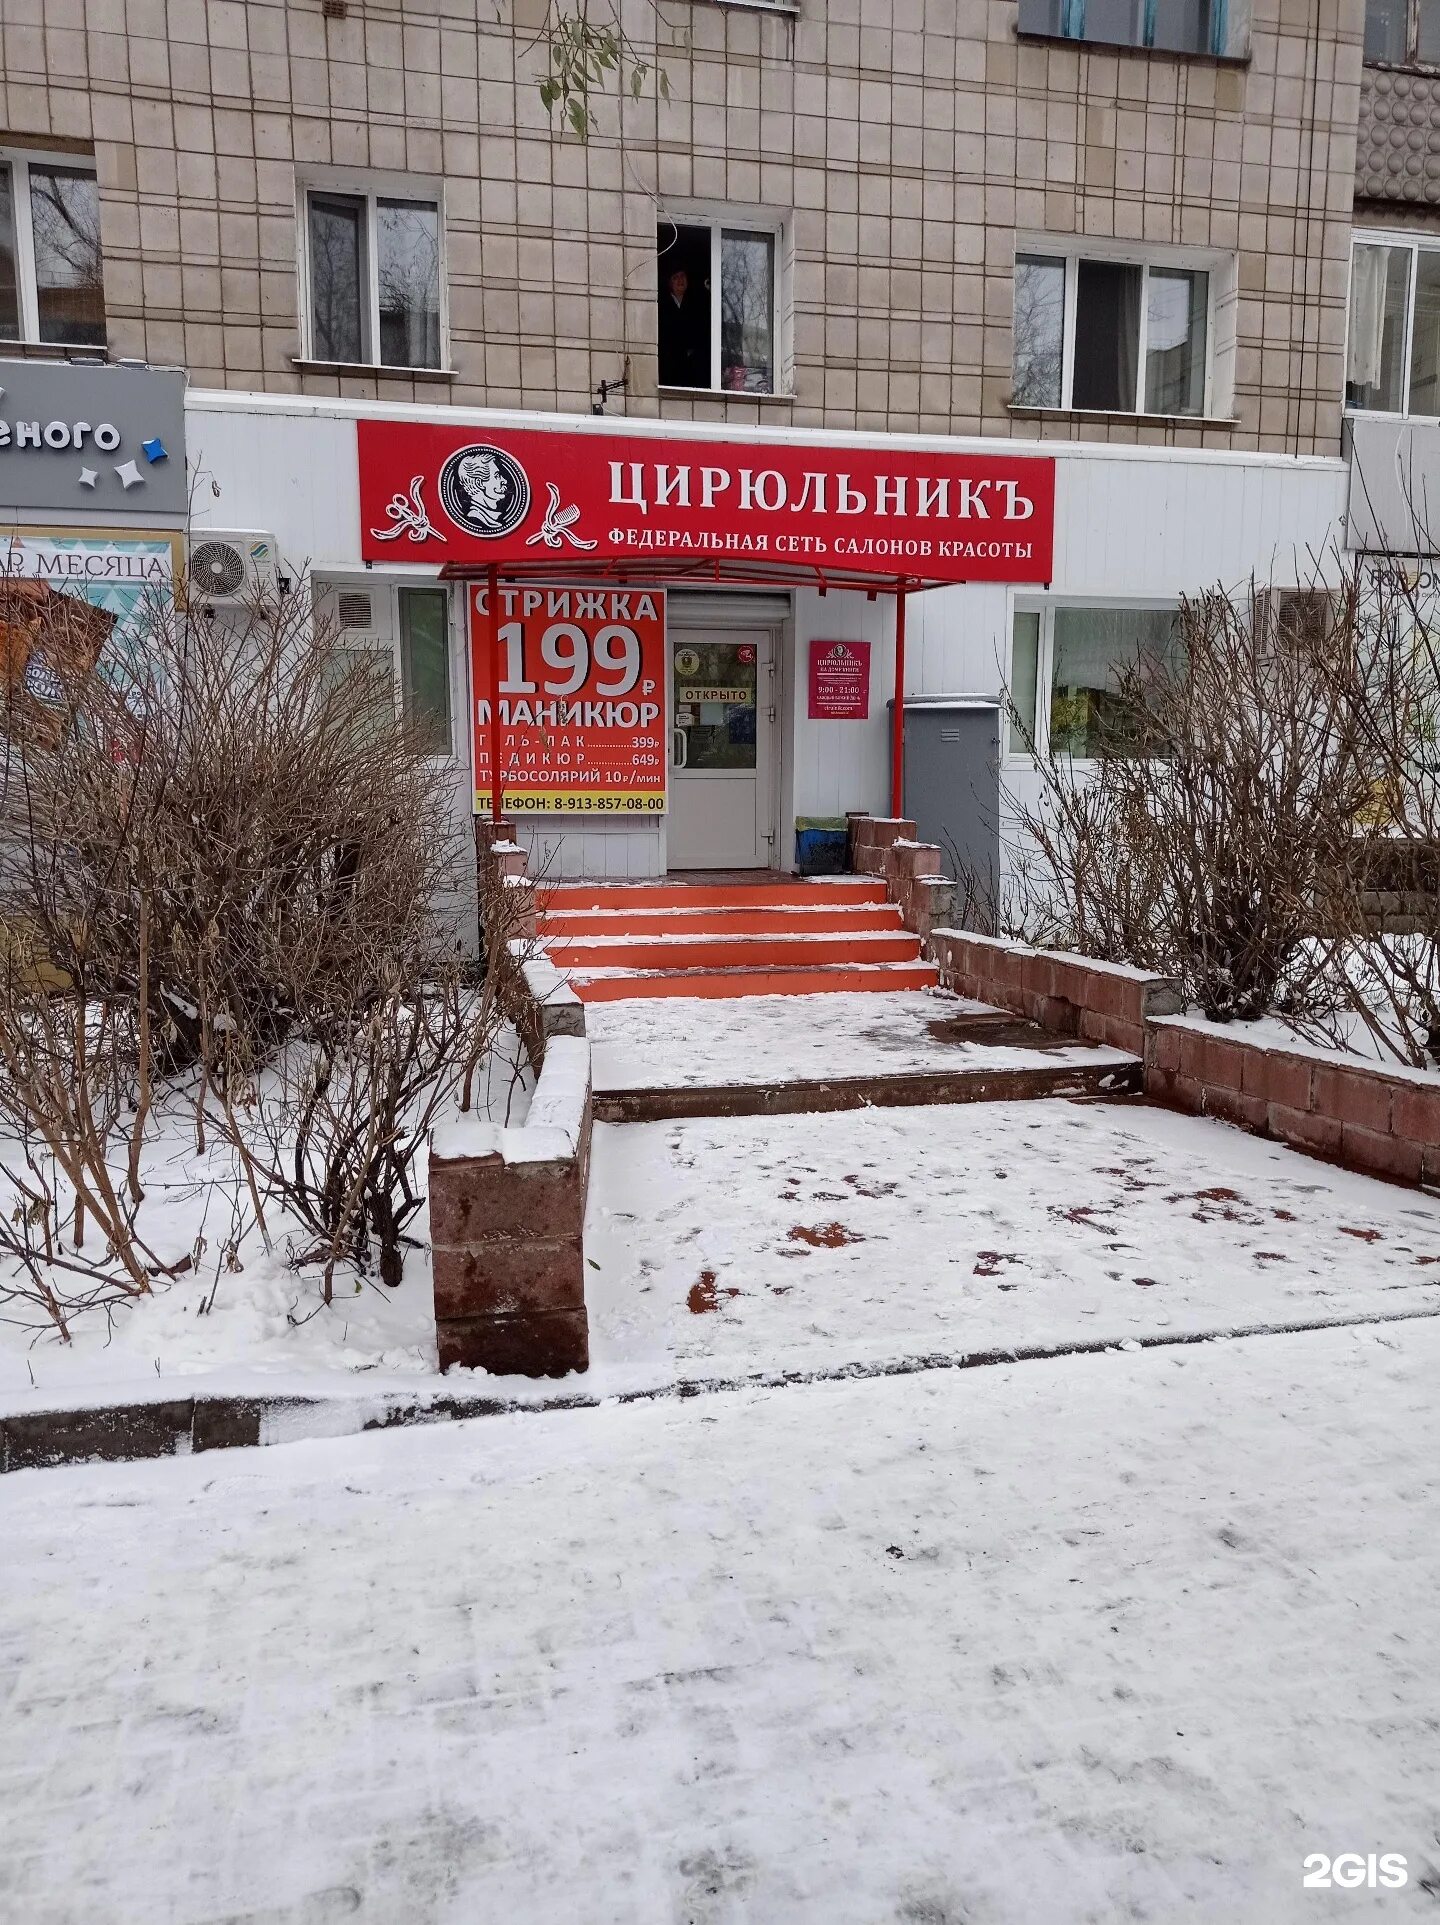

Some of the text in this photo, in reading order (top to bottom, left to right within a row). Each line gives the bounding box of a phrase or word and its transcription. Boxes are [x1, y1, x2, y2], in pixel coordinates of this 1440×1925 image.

[608, 461, 1034, 520] ЦИРЮЛЬНИКЪ
[608, 528, 1033, 559] ФЕДЕРАЛЬНАЯ СЕТЬ САЛОНОВ КРАСОТЫ
[36, 553, 166, 580] МЕСЯЦА
[475, 589, 658, 621] СТРИЖКА
[685, 690, 747, 700] ОТКРЫТО
[839, 686, 860, 694] 21:00
[477, 699, 660, 728] МАНИКЮР
[479, 734, 585, 748] ГЛЬ-ЛАК
[479, 752, 585, 767] ПДИКЮР
[554, 796, 664, 810] 8-913-857-08-00
